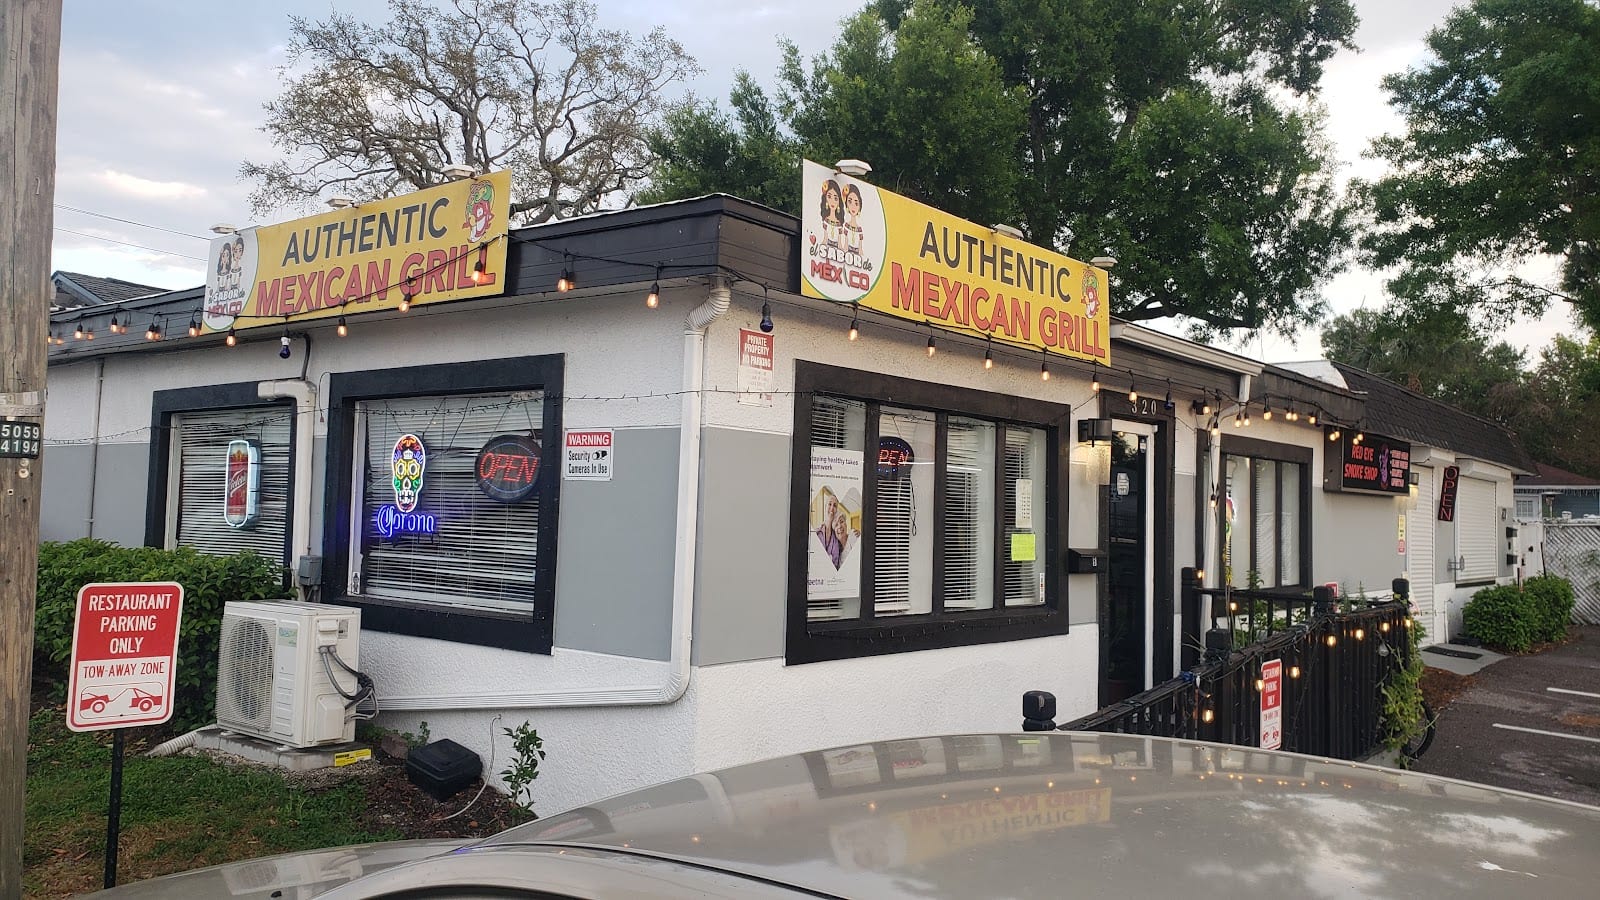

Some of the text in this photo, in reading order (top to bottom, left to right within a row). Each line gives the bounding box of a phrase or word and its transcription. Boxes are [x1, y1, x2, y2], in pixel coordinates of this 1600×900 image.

[282, 197, 450, 267] AUTHENTIC
[819, 244, 862, 268] SABOR
[863, 258, 873, 271] de
[919, 221, 1071, 302] AUTHENTIC
[255, 244, 496, 318] MEXICAN GRILL
[891, 262, 1106, 358] MEXICAN GRILL
[744, 342, 770, 356] PROPERTY
[750, 355, 771, 368] PARKING
[1131, 399, 1157, 415] 320
[1, 424, 40, 439] 5059
[568, 434, 610, 446] WARNING
[0, 440, 39, 454] 4194
[1351, 444, 1363, 460] RED
[568, 450, 591, 463] Security
[879, 449, 909, 467] PEN
[479, 452, 538, 484] OPEN
[568, 463, 608, 474] Cameras In Use
[1343, 463, 1364, 479] SMOKE
[1364, 465, 1378, 481] SHOP
[1440, 466, 1458, 521] OPEN
[377, 504, 435, 538] Corona
[88, 593, 173, 612] RESTAURANT
[100, 615, 157, 633] PARKING
[109, 636, 144, 654] ONLY
[83, 661, 165, 679] TOW-AWAY ZONE
